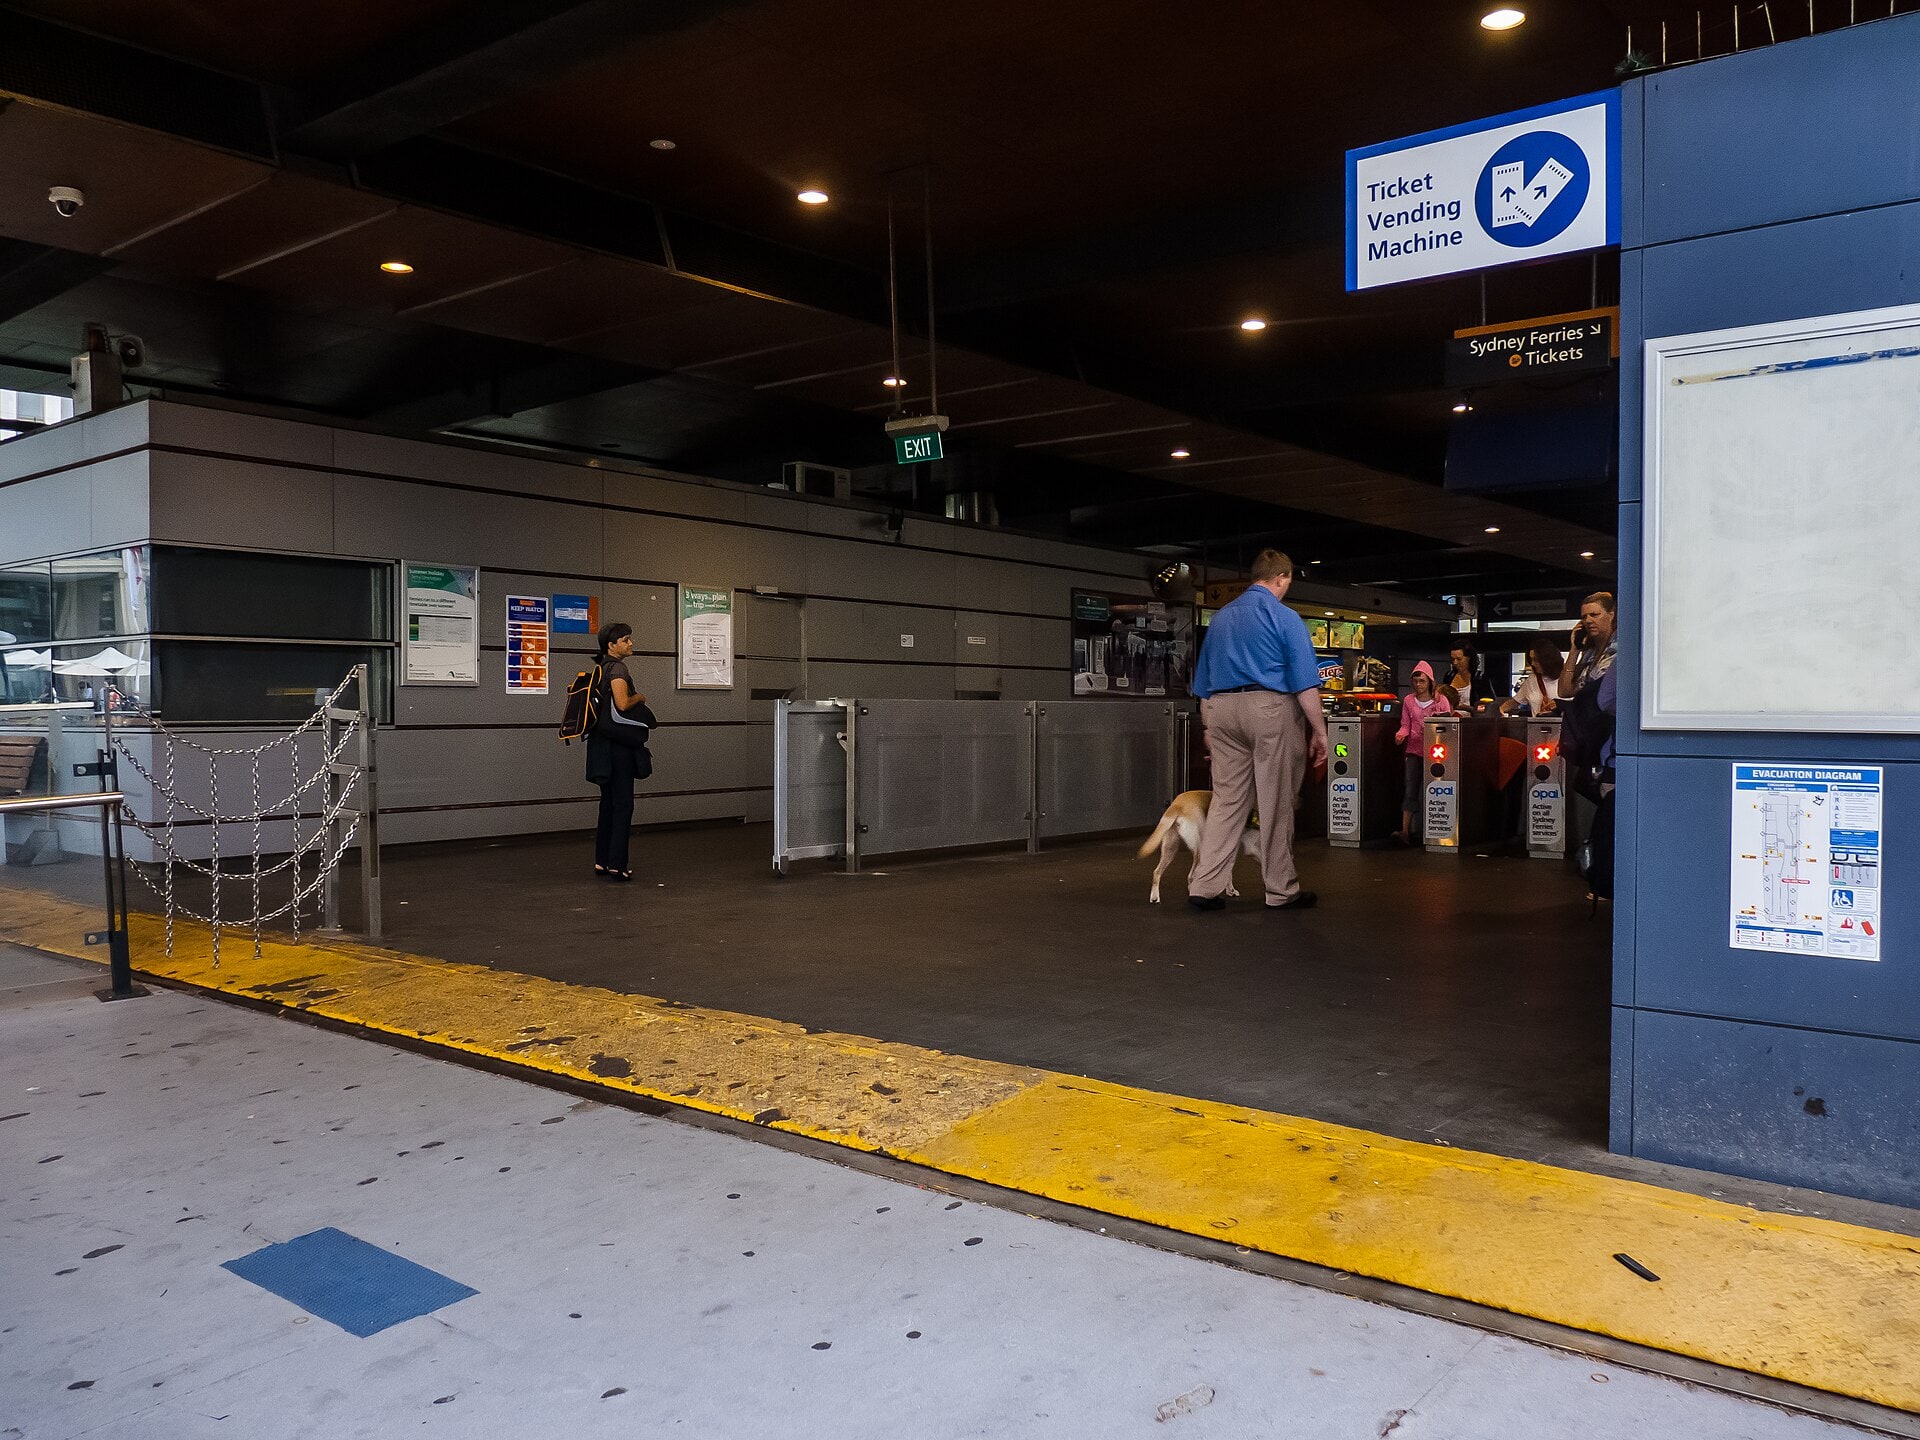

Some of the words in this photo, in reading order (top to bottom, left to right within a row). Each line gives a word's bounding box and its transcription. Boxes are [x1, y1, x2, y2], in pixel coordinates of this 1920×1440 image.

[1367, 172, 1433, 203] Ticket
[1367, 199, 1462, 232] Vending
[1367, 229, 1464, 262] Machine
[1470, 336, 1526, 357] Sydney
[1530, 326, 1584, 346] Ferries
[1525, 347, 1584, 366] Tickets
[903, 436, 932, 459] EXIT
[690, 590, 709, 602] ways
[712, 591, 728, 602] plan
[525, 605, 545, 613] WATCH
[1318, 666, 1344, 680] eters
[1752, 769, 1813, 780] EVACUATION
[1815, 770, 1862, 781] DIAGRAM
[1332, 783, 1356, 794] opal
[1428, 786, 1454, 797] opal
[1531, 789, 1559, 801] opal
[1332, 808, 1353, 816] Sydney
[1428, 812, 1450, 821] Sydney
[1532, 816, 1556, 824] Sydney
